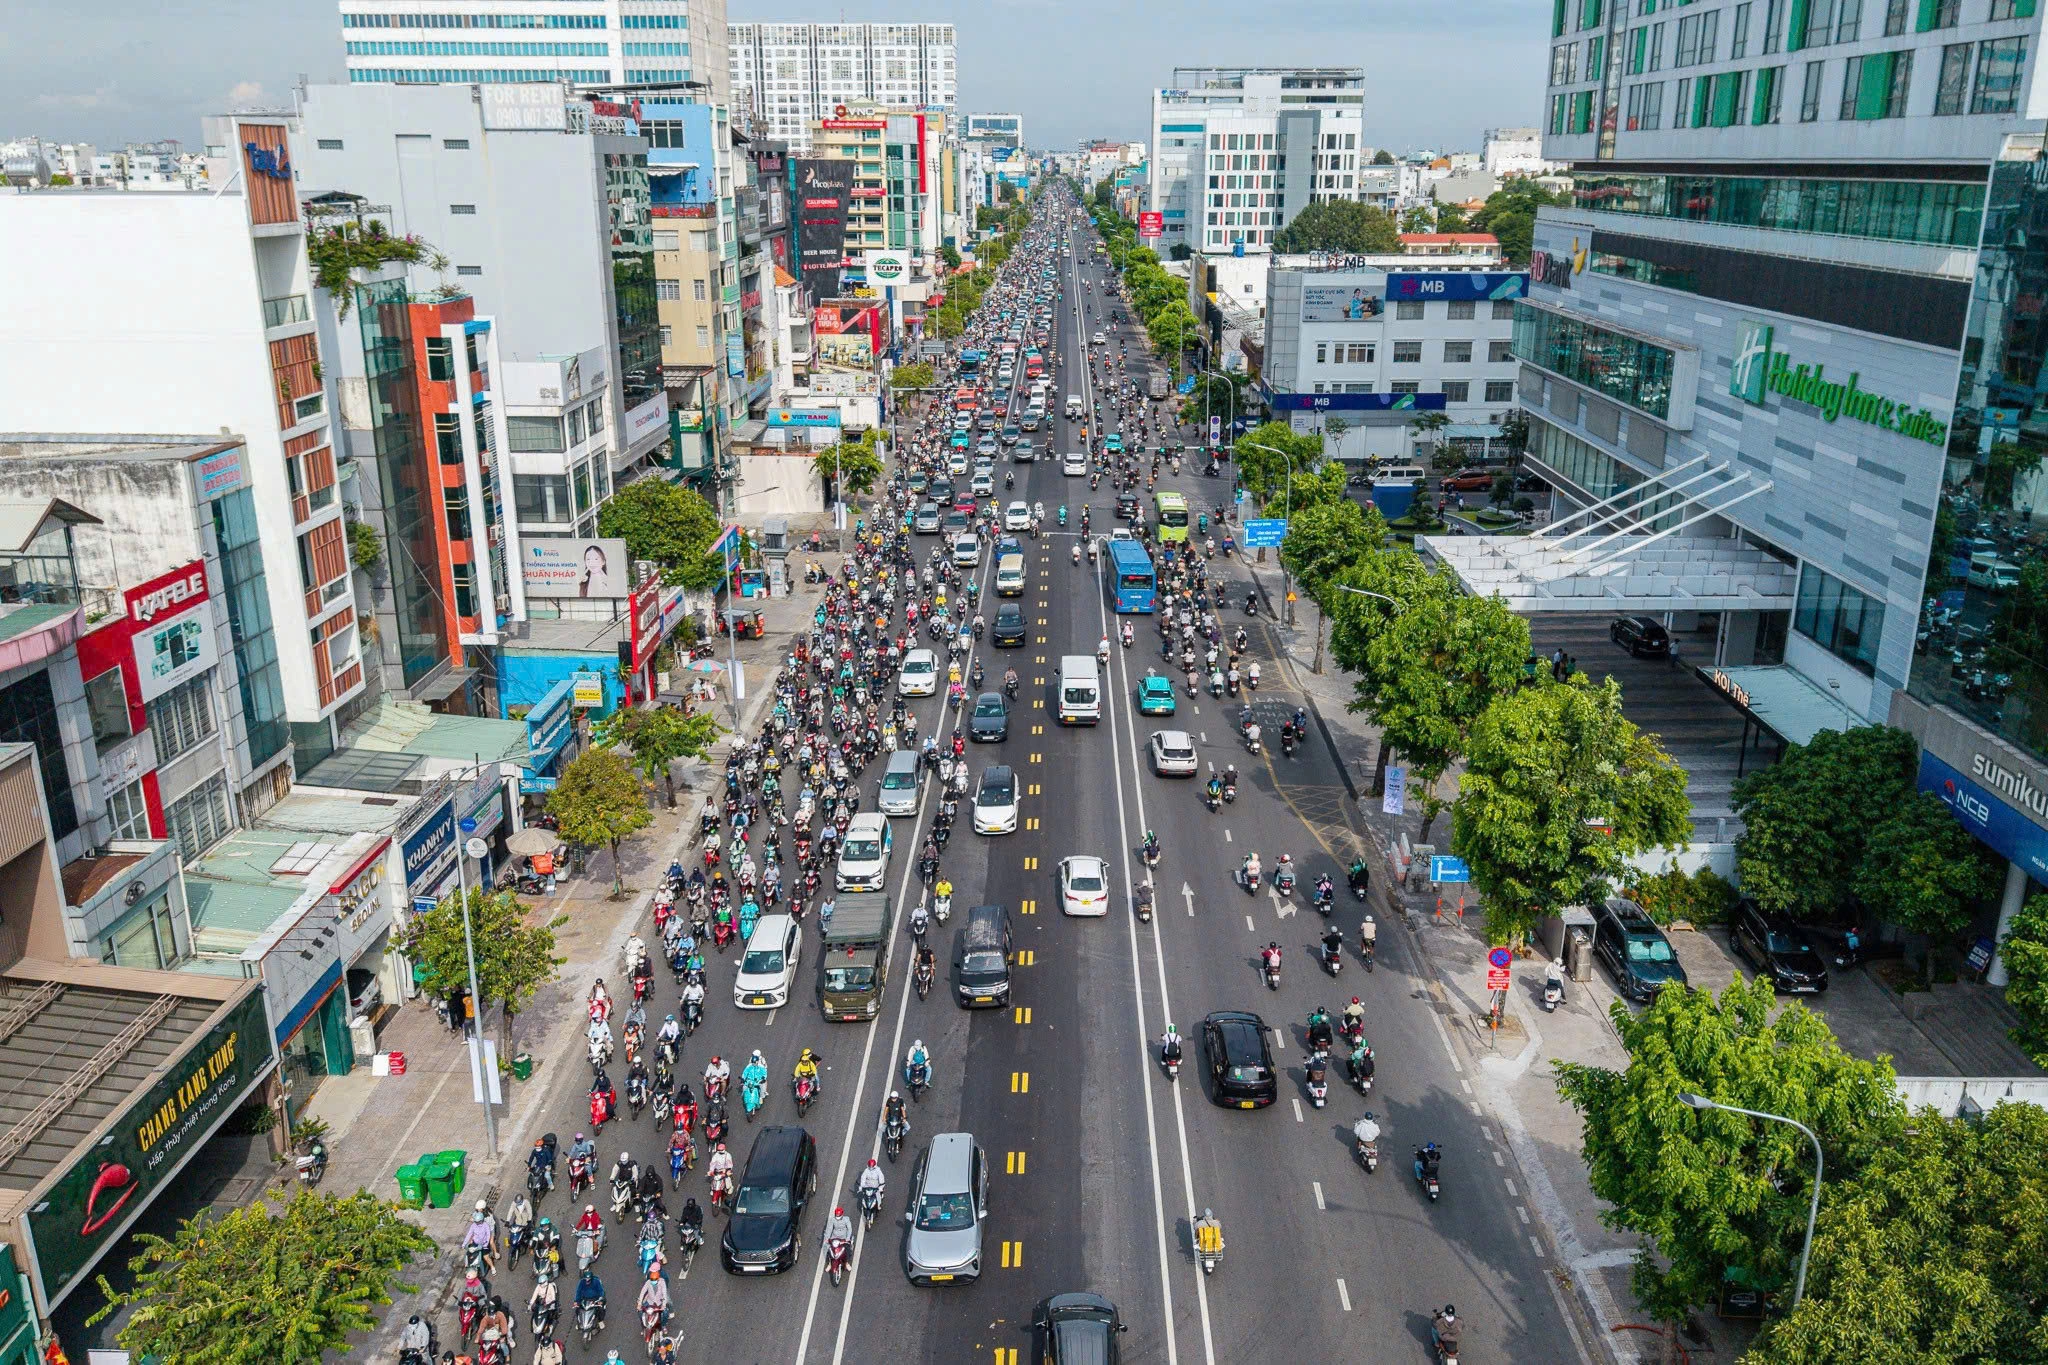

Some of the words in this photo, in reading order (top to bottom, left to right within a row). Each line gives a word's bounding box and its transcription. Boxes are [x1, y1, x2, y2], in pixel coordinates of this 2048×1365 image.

[485, 87, 517, 104] FOR
[522, 87, 561, 104] RENT
[496, 108, 522, 126] 0908
[1344, 256, 1366, 269] MB
[1530, 250, 1573, 289] HDBank
[1421, 280, 1445, 293] MB
[1314, 397, 1330, 406] MB
[1767, 351, 1845, 424] Holiday
[1842, 371, 1884, 425] Inn
[1878, 399, 1895, 430] &
[1893, 402, 1948, 447] Suites
[526, 560, 546, 568] THỐNG
[552, 568, 577, 578] PHÁP
[1714, 668, 1731, 694] KOI
[1733, 682, 1749, 708] Thé
[1957, 789, 1989, 822] NCB
[139, 1098, 177, 1153] CHANG
[177, 1067, 208, 1113] KANG
[148, 1150, 165, 1170] Hấp
[199, 1093, 218, 1116] Hong
[218, 1075, 236, 1097] Kong
